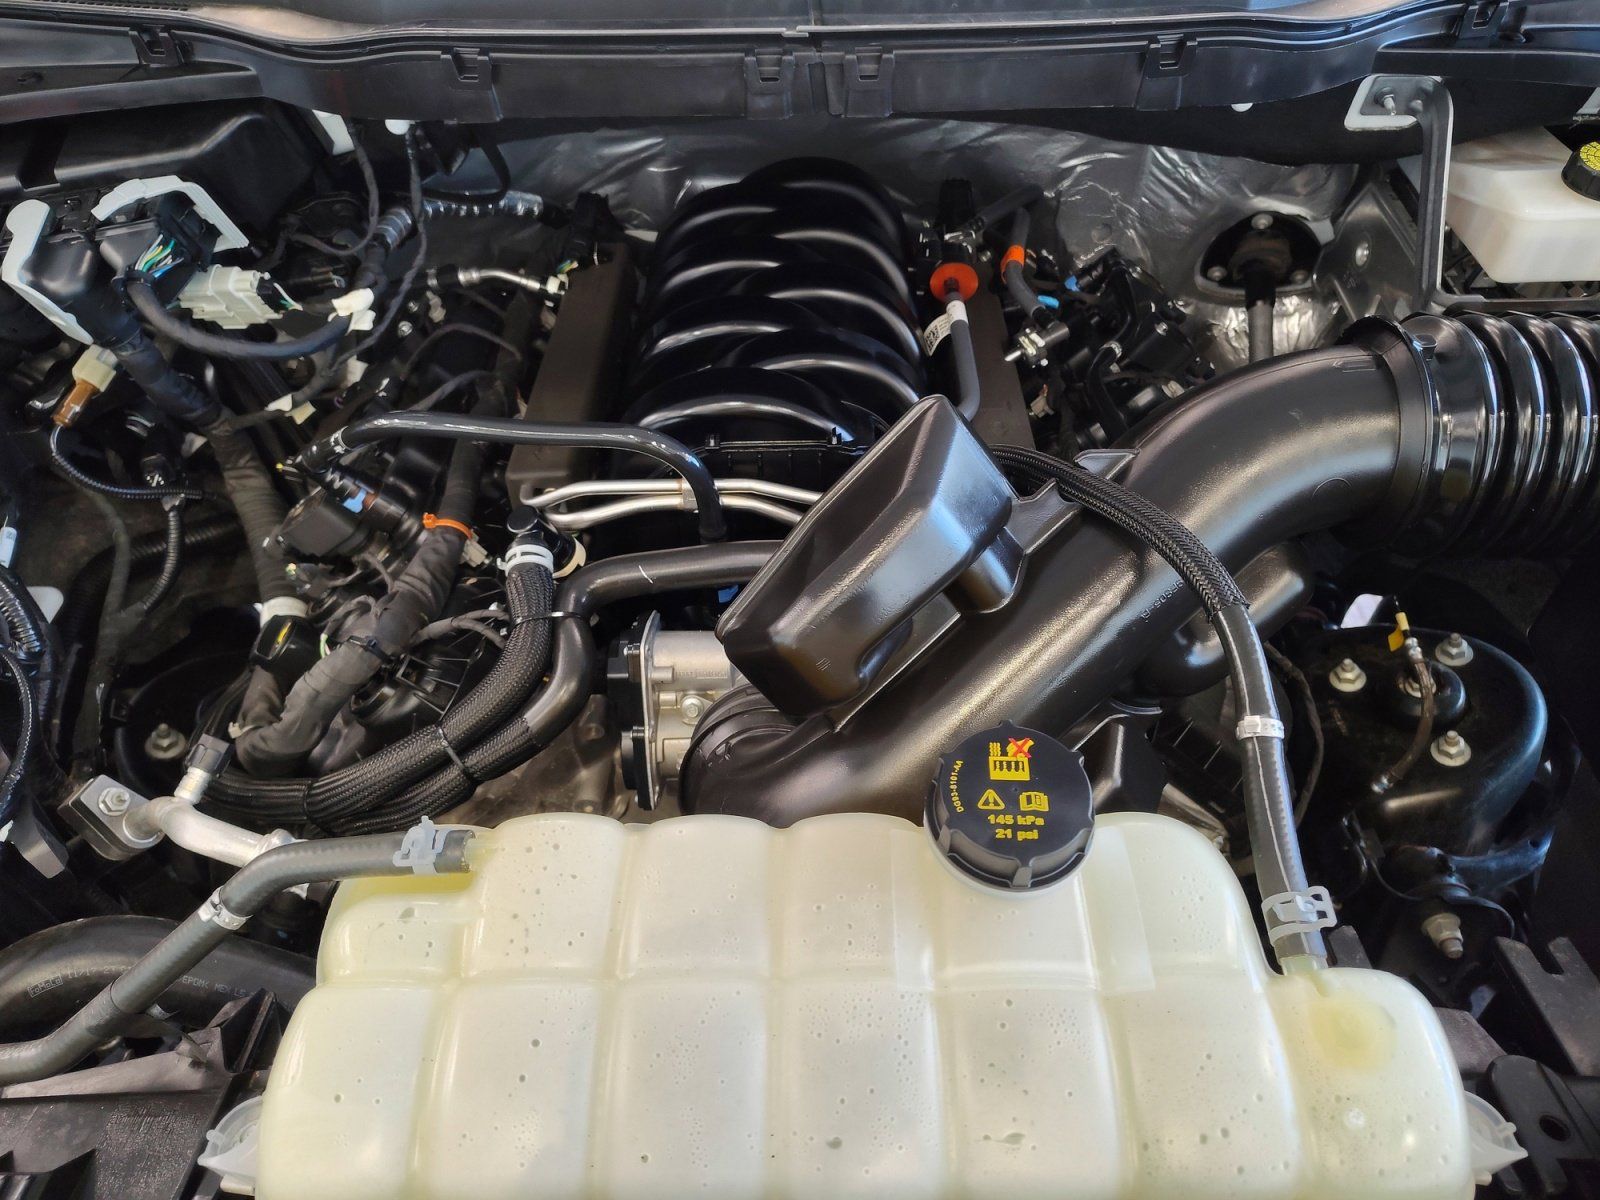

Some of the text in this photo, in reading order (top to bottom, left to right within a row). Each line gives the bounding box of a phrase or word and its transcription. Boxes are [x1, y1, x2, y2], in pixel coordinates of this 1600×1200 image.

[987, 814, 1045, 826] 145 kPa
[995, 828, 1039, 841] 21 psi
